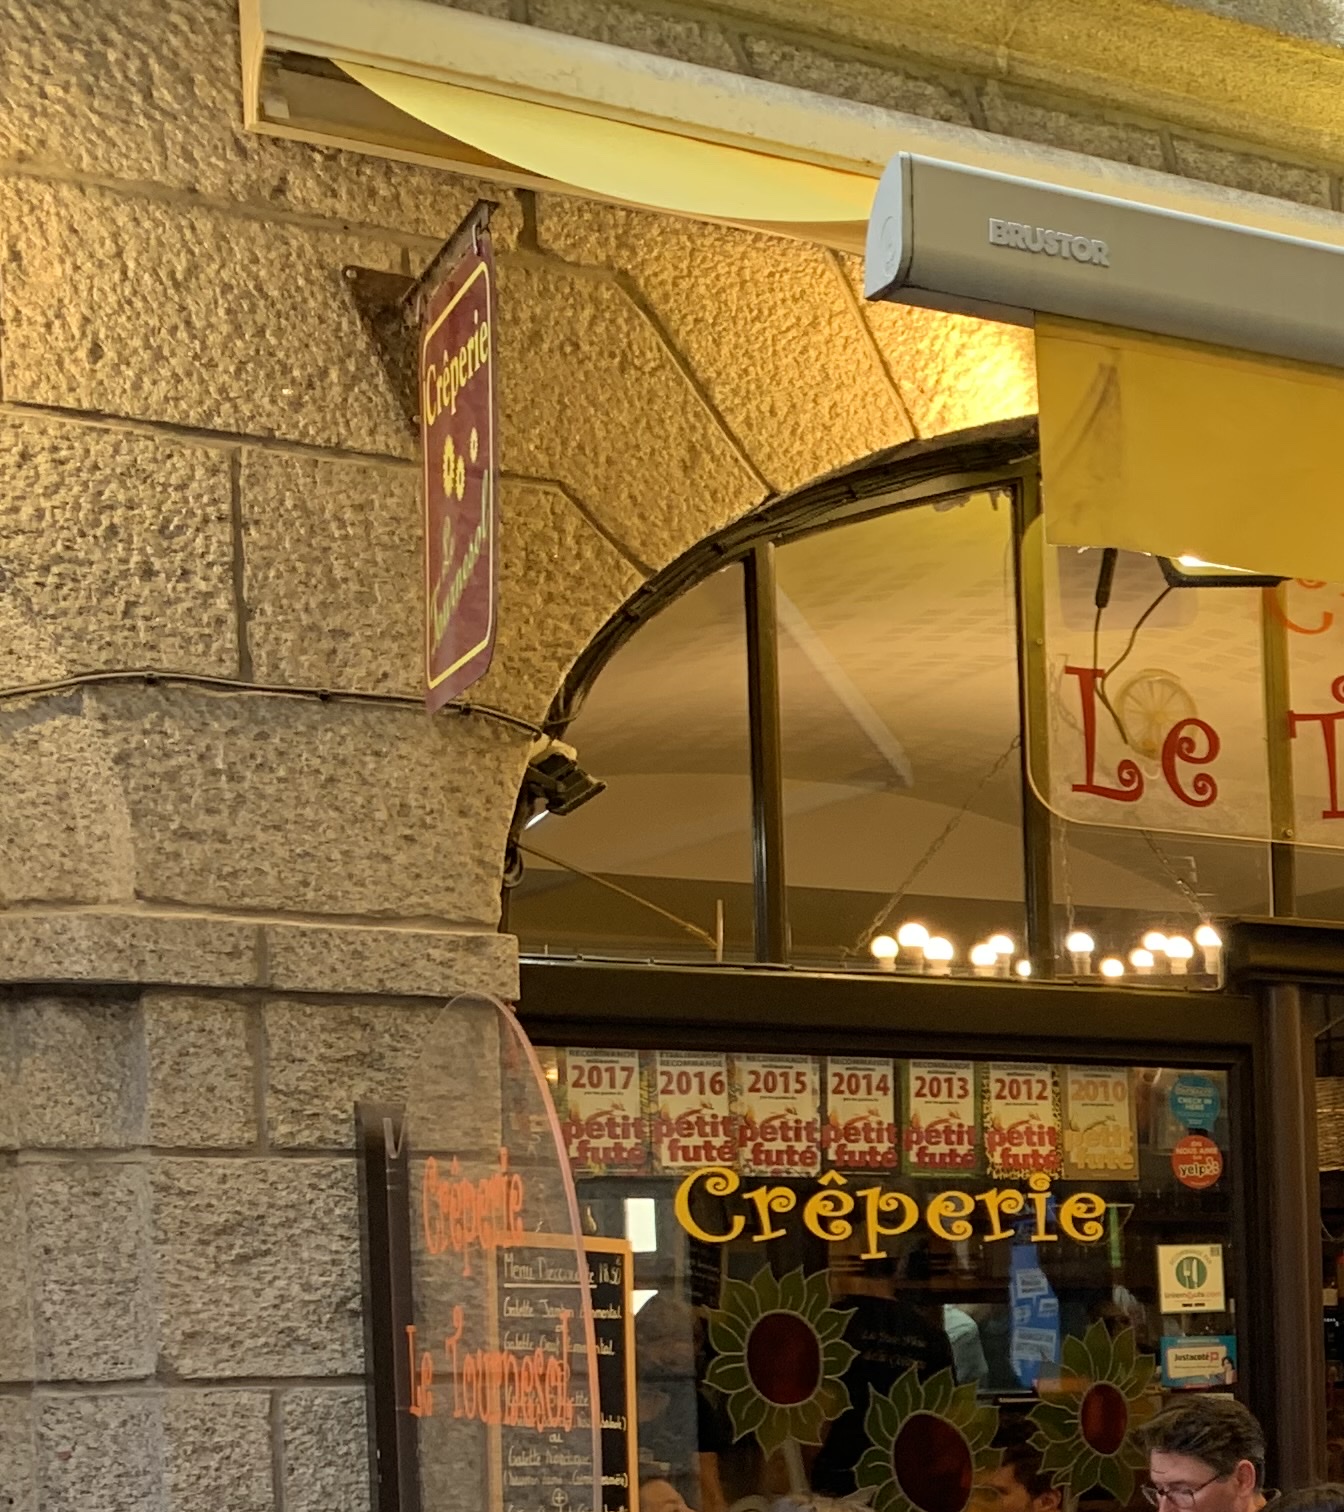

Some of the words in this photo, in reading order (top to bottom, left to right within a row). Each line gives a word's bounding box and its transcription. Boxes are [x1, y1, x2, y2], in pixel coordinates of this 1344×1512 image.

[988, 217, 1111, 268] BRUSTOR
[426, 308, 489, 426] Crêperie
[1065, 664, 1220, 807] Le
[571, 1064, 635, 1090] 2017
[659, 1070, 726, 1096] 2016
[747, 1070, 808, 1095] 2015
[831, 1072, 891, 1097] 2014
[914, 1075, 970, 1100] 2013
[994, 1077, 1049, 1101] 2012
[561, 1114, 648, 1143] petit
[653, 1114, 738, 1144] petit
[738, 1115, 819, 1147] petit
[821, 1121, 898, 1149] petit
[903, 1124, 977, 1150] petit
[985, 1125, 1057, 1151] petit
[1179, 1163, 1207, 1177] yelp
[674, 1166, 1107, 1260] Crêperie
[405, 1323, 434, 1418] Le
